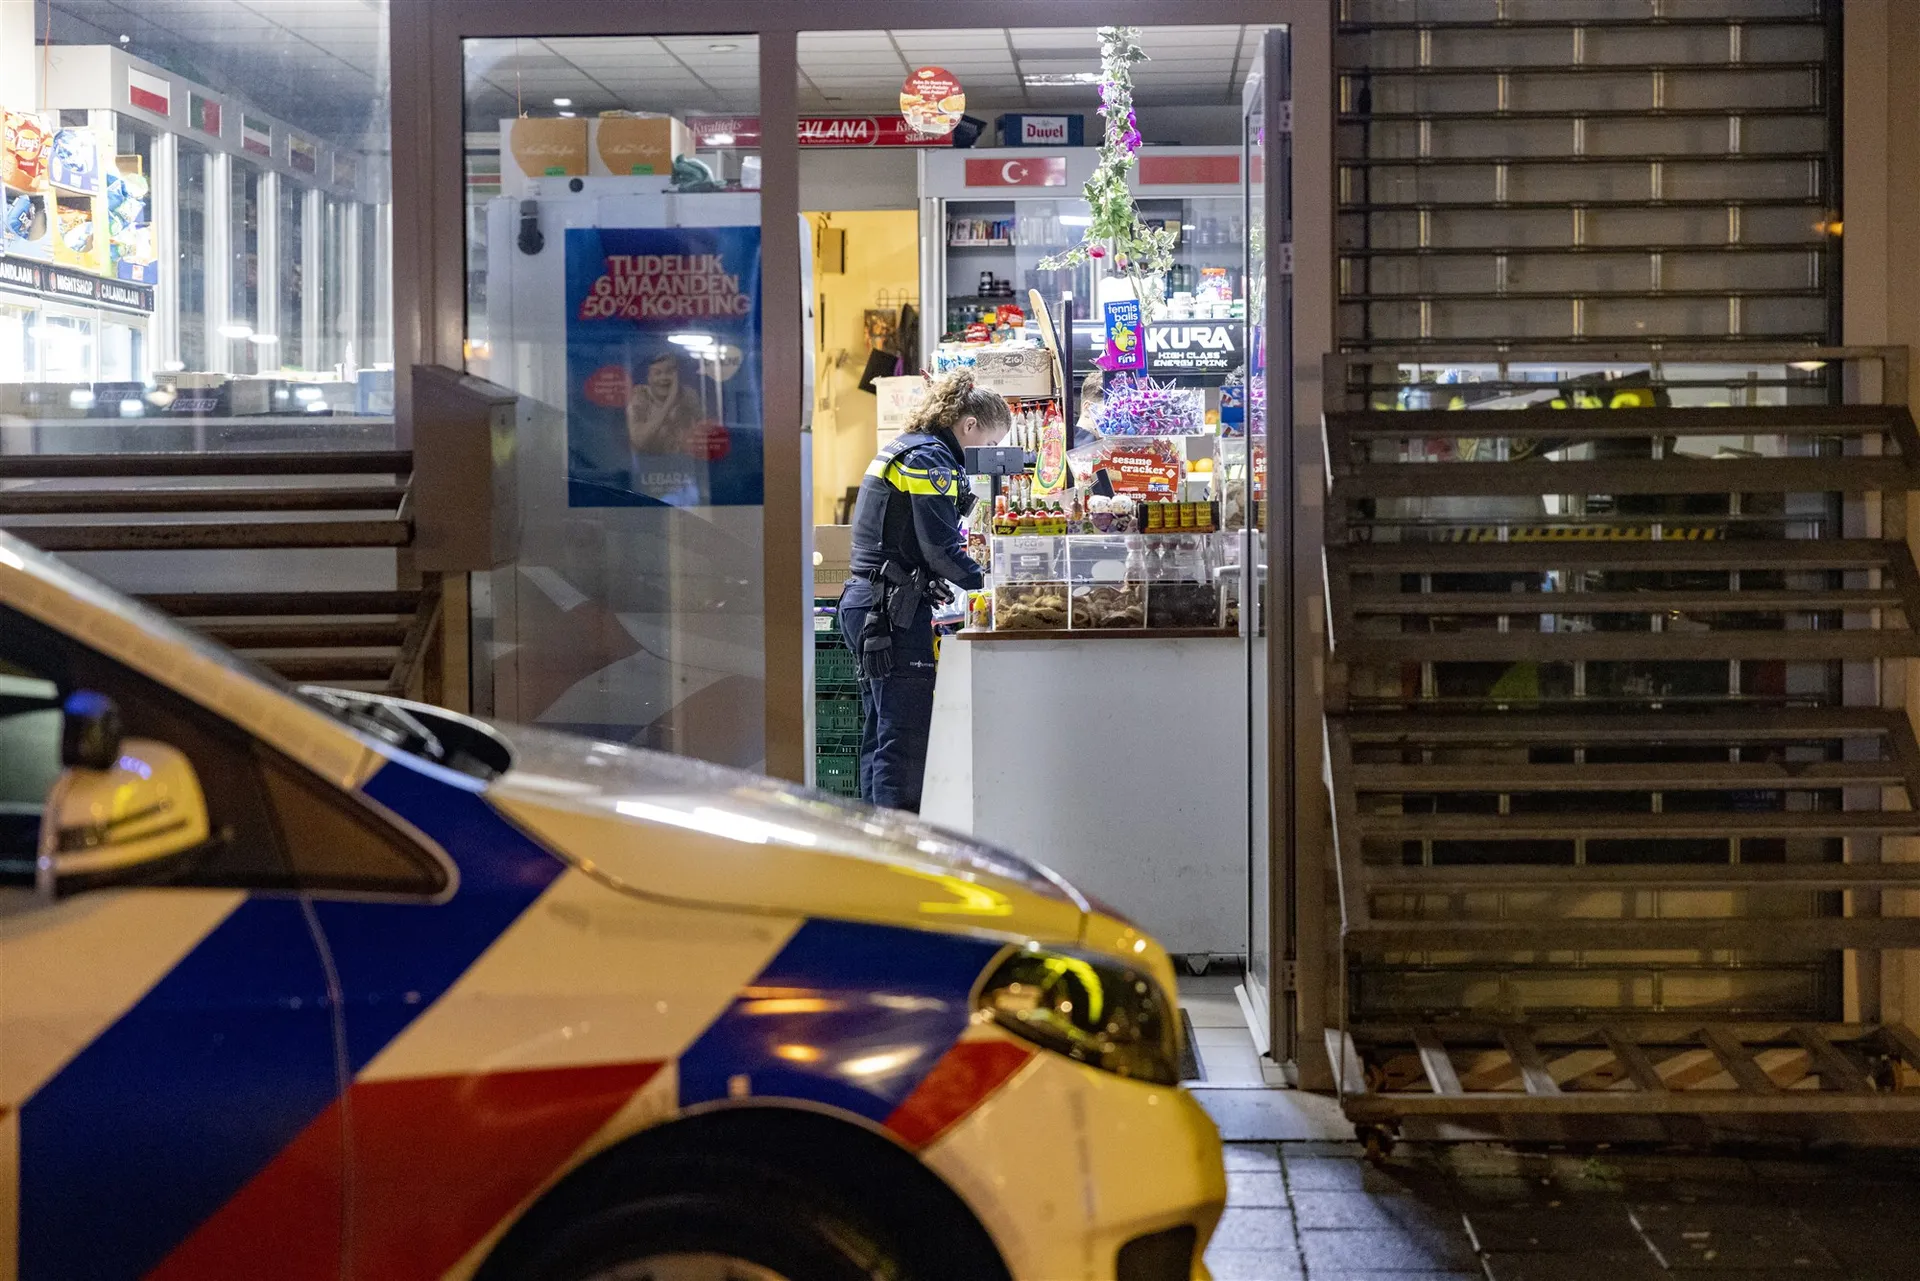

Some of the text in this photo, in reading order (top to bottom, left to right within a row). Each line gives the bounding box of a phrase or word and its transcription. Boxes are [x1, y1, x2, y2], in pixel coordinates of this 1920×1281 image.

[798, 121, 868, 138] EVLANA
[1026, 123, 1064, 138] Duvel
[608, 254, 725, 275] TIJDELIJK
[0, 262, 33, 284] ANDLAAN
[56, 274, 139, 305] NIGHTSHOP CALANDLAAN
[594, 275, 739, 295] 6 MAANDEN
[583, 295, 750, 316] 50% KORTING
[1108, 303, 1138, 314] tennis
[1114, 312, 1139, 322] balls
[1091, 326, 1235, 352] SKURA
[1153, 360, 1228, 368] ENERGY DRINK
[1158, 352, 1185, 360] HIGH
[1112, 455, 1152, 466] sesame
[1121, 463, 1165, 474] cracker
